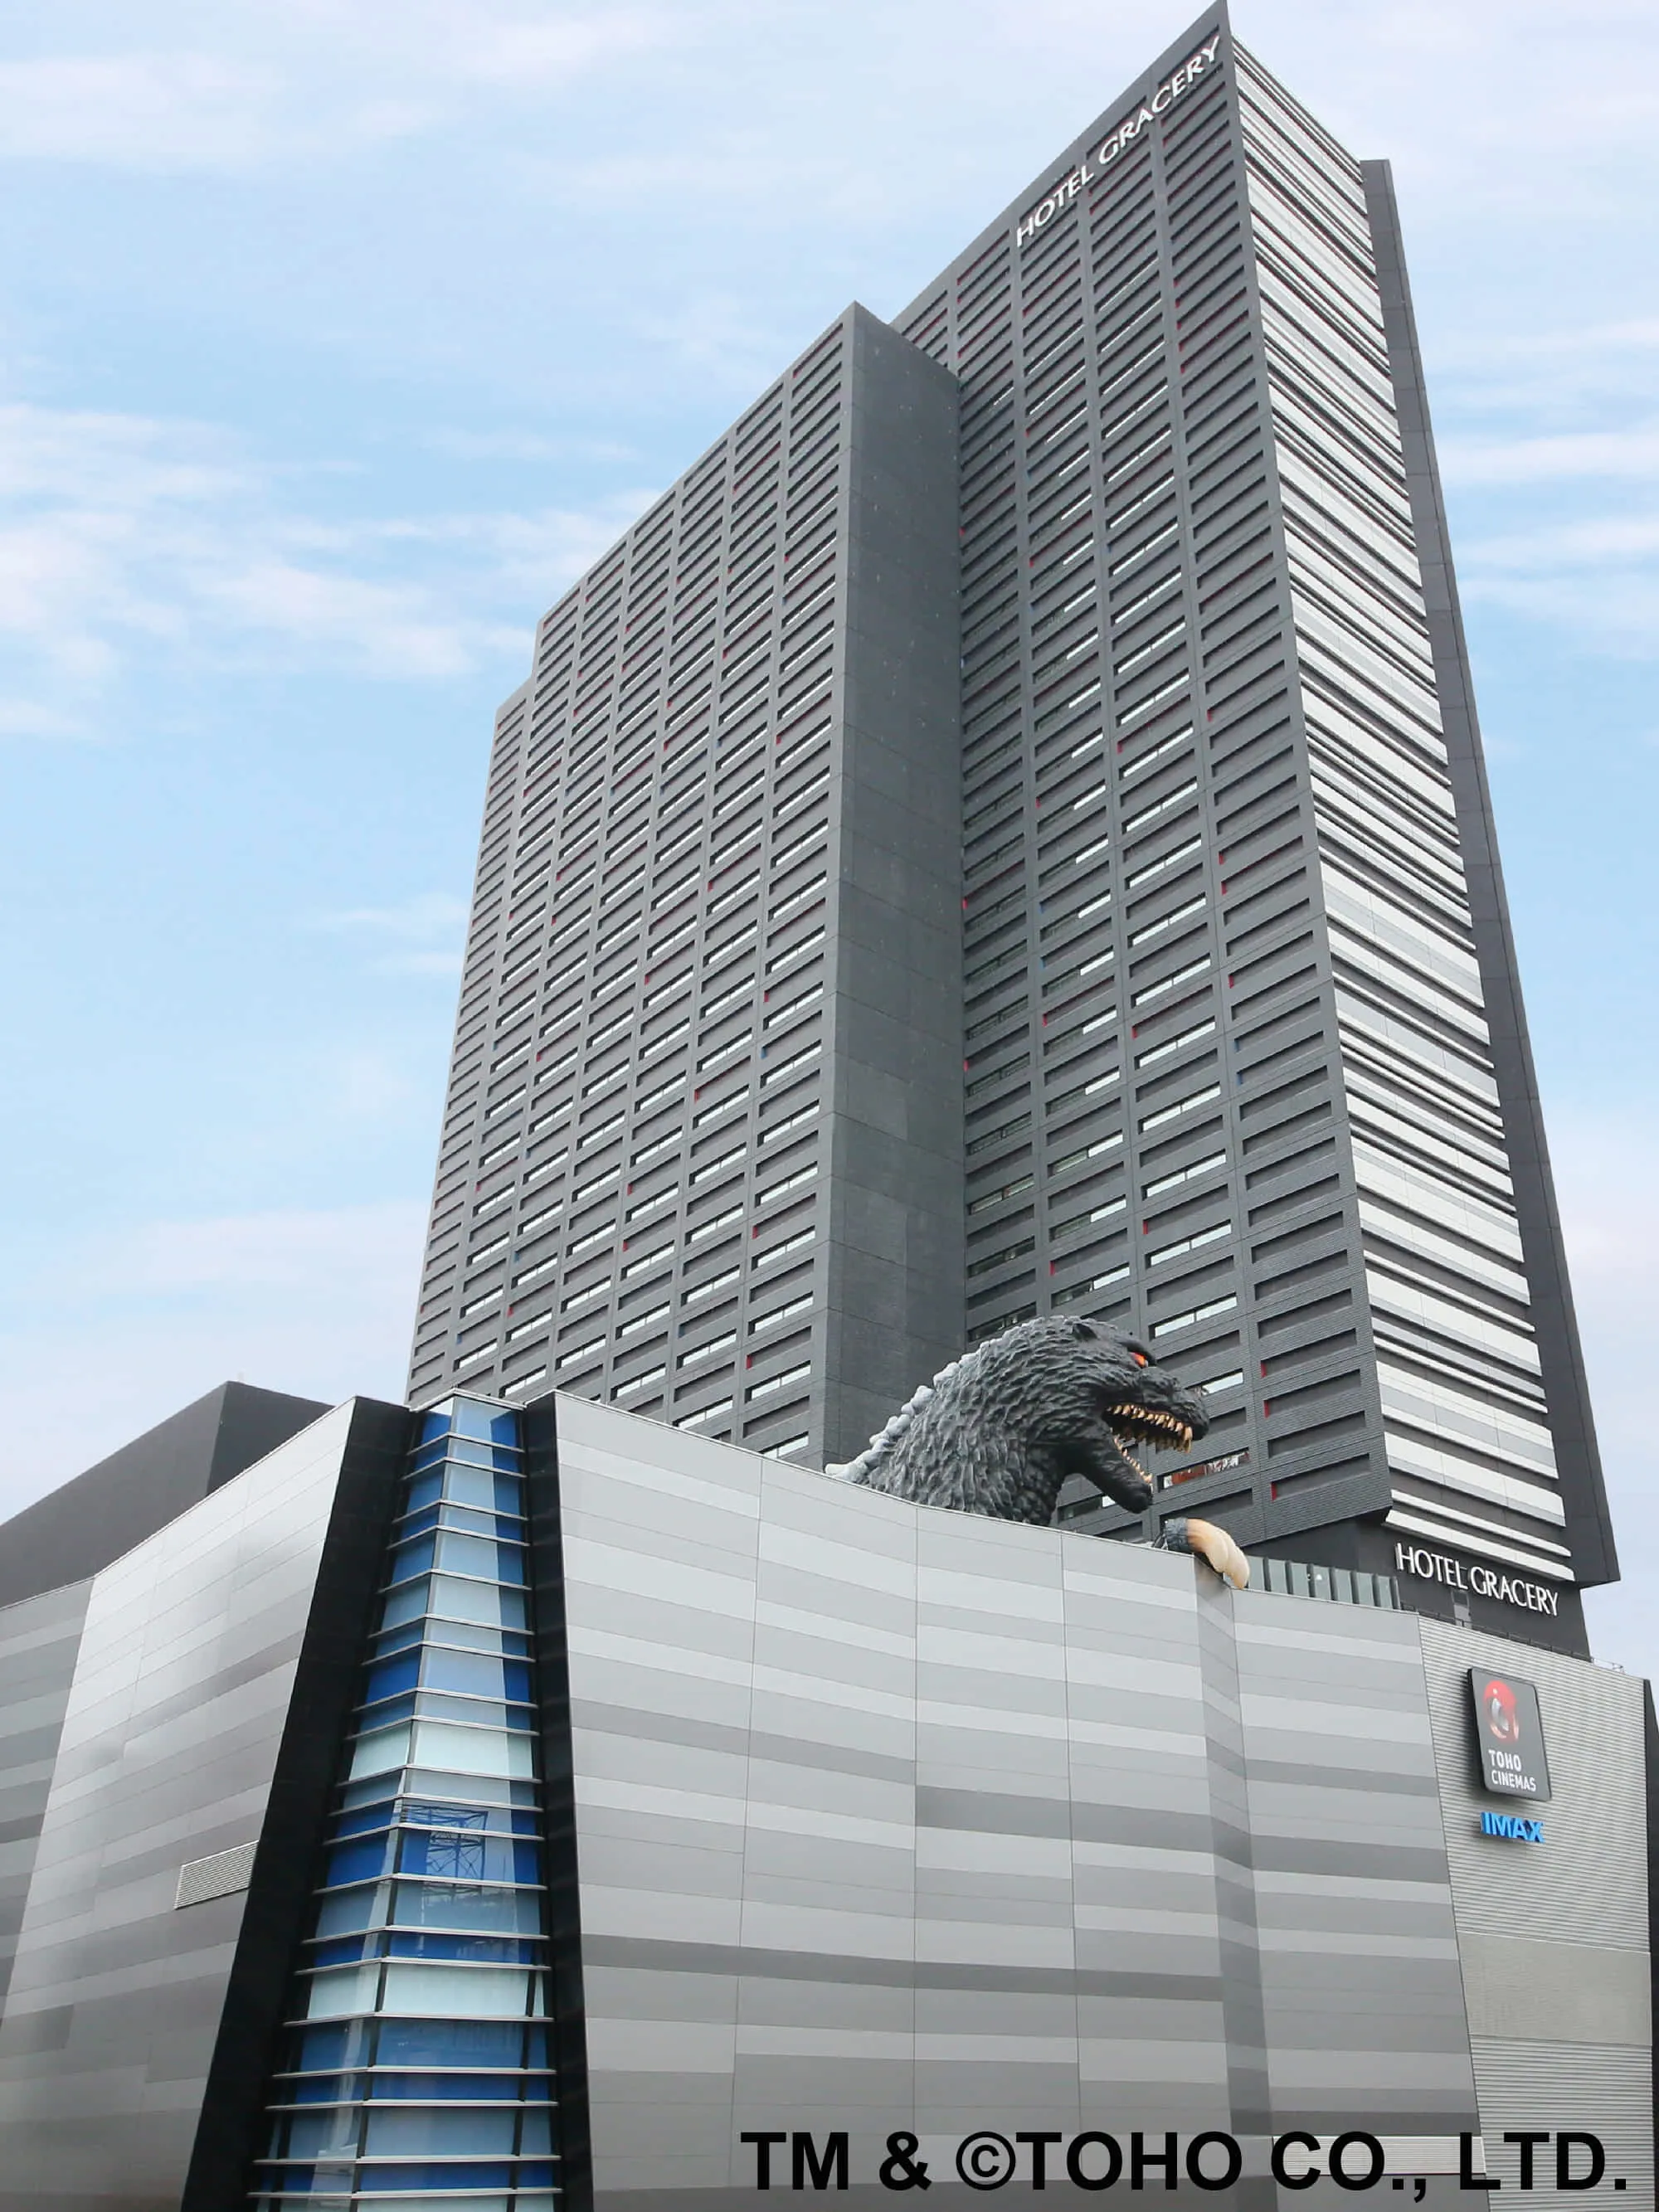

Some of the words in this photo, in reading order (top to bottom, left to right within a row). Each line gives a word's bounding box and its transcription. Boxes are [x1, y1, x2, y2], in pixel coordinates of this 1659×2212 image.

[1016, 165, 1094, 247] HOTEL
[1098, 36, 1219, 164] GRACERY
[1395, 1543, 1468, 1590] HOTEL
[1471, 1566, 1559, 1616] GRACERY
[1488, 1749, 1522, 1772] TOHO
[1491, 1769, 1536, 1792] CINEMAS
[1481, 1811, 1545, 1844] IMAX
